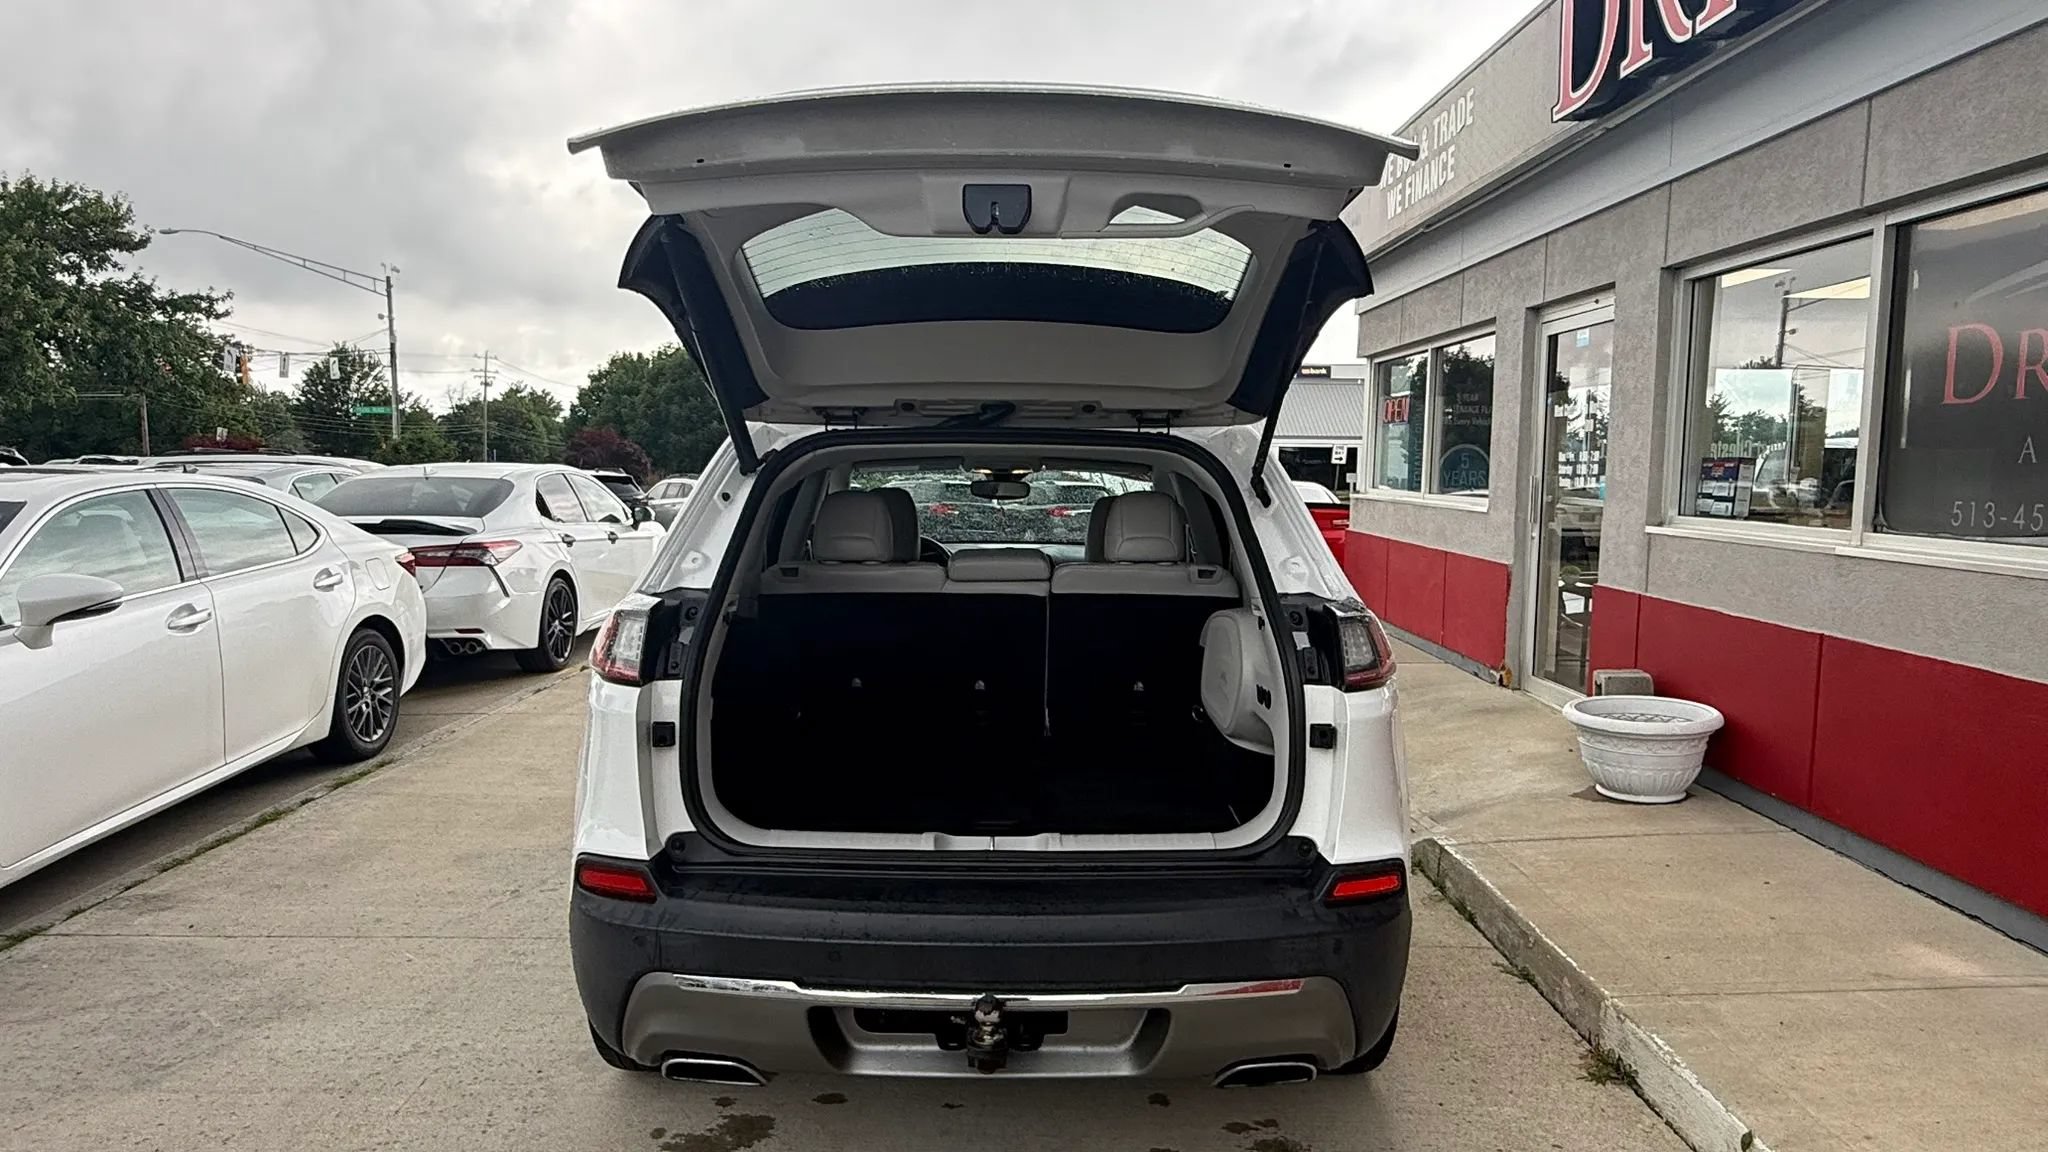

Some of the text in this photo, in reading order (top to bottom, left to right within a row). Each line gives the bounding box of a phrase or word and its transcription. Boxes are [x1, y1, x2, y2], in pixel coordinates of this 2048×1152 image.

[1420, 126, 1429, 160] &
[1433, 87, 1475, 150] TRADE
[1387, 143, 1456, 220] WE FINANCE
[1383, 397, 1410, 423] OPEN
[1460, 452, 1470, 469] 5
[1443, 470, 1487, 487] YEARS
[1951, 500, 2045, 531] 513-45
